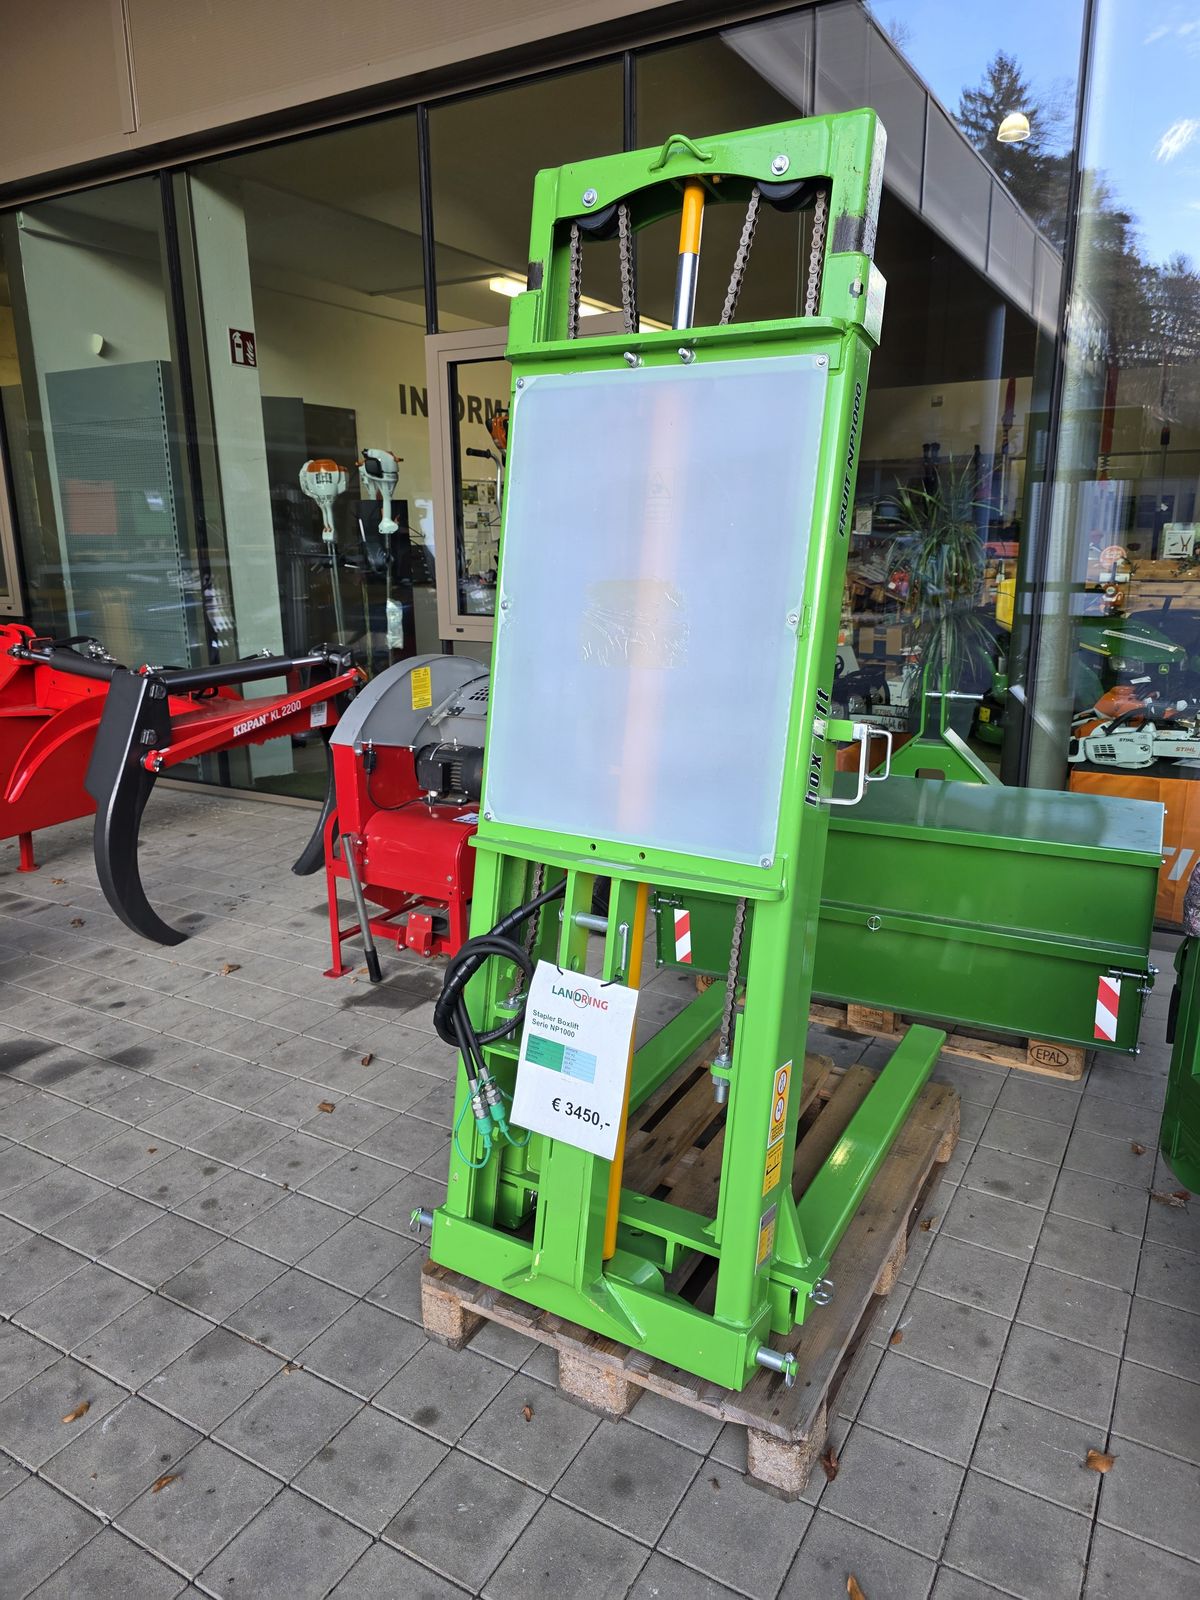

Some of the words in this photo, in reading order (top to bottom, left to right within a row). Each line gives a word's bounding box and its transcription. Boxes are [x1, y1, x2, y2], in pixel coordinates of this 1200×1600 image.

[838, 472, 852, 538] FRUIT
[847, 382, 862, 470] NP1000
[270, 709, 281, 721] KL
[281, 700, 302, 717] 2200
[1175, 745, 1196, 753] STIHL
[804, 751, 823, 808] box
[551, 985, 609, 1011] LANDRING
[531, 1018, 549, 1029] Serie
[549, 1023, 576, 1038] NP1000
[532, 1009, 556, 1022] Stapler
[557, 1017, 580, 1031] Boxlift
[1035, 1048, 1063, 1065] EPAL
[551, 1097, 562, 1112] €
[565, 1101, 611, 1131] 3450,-
